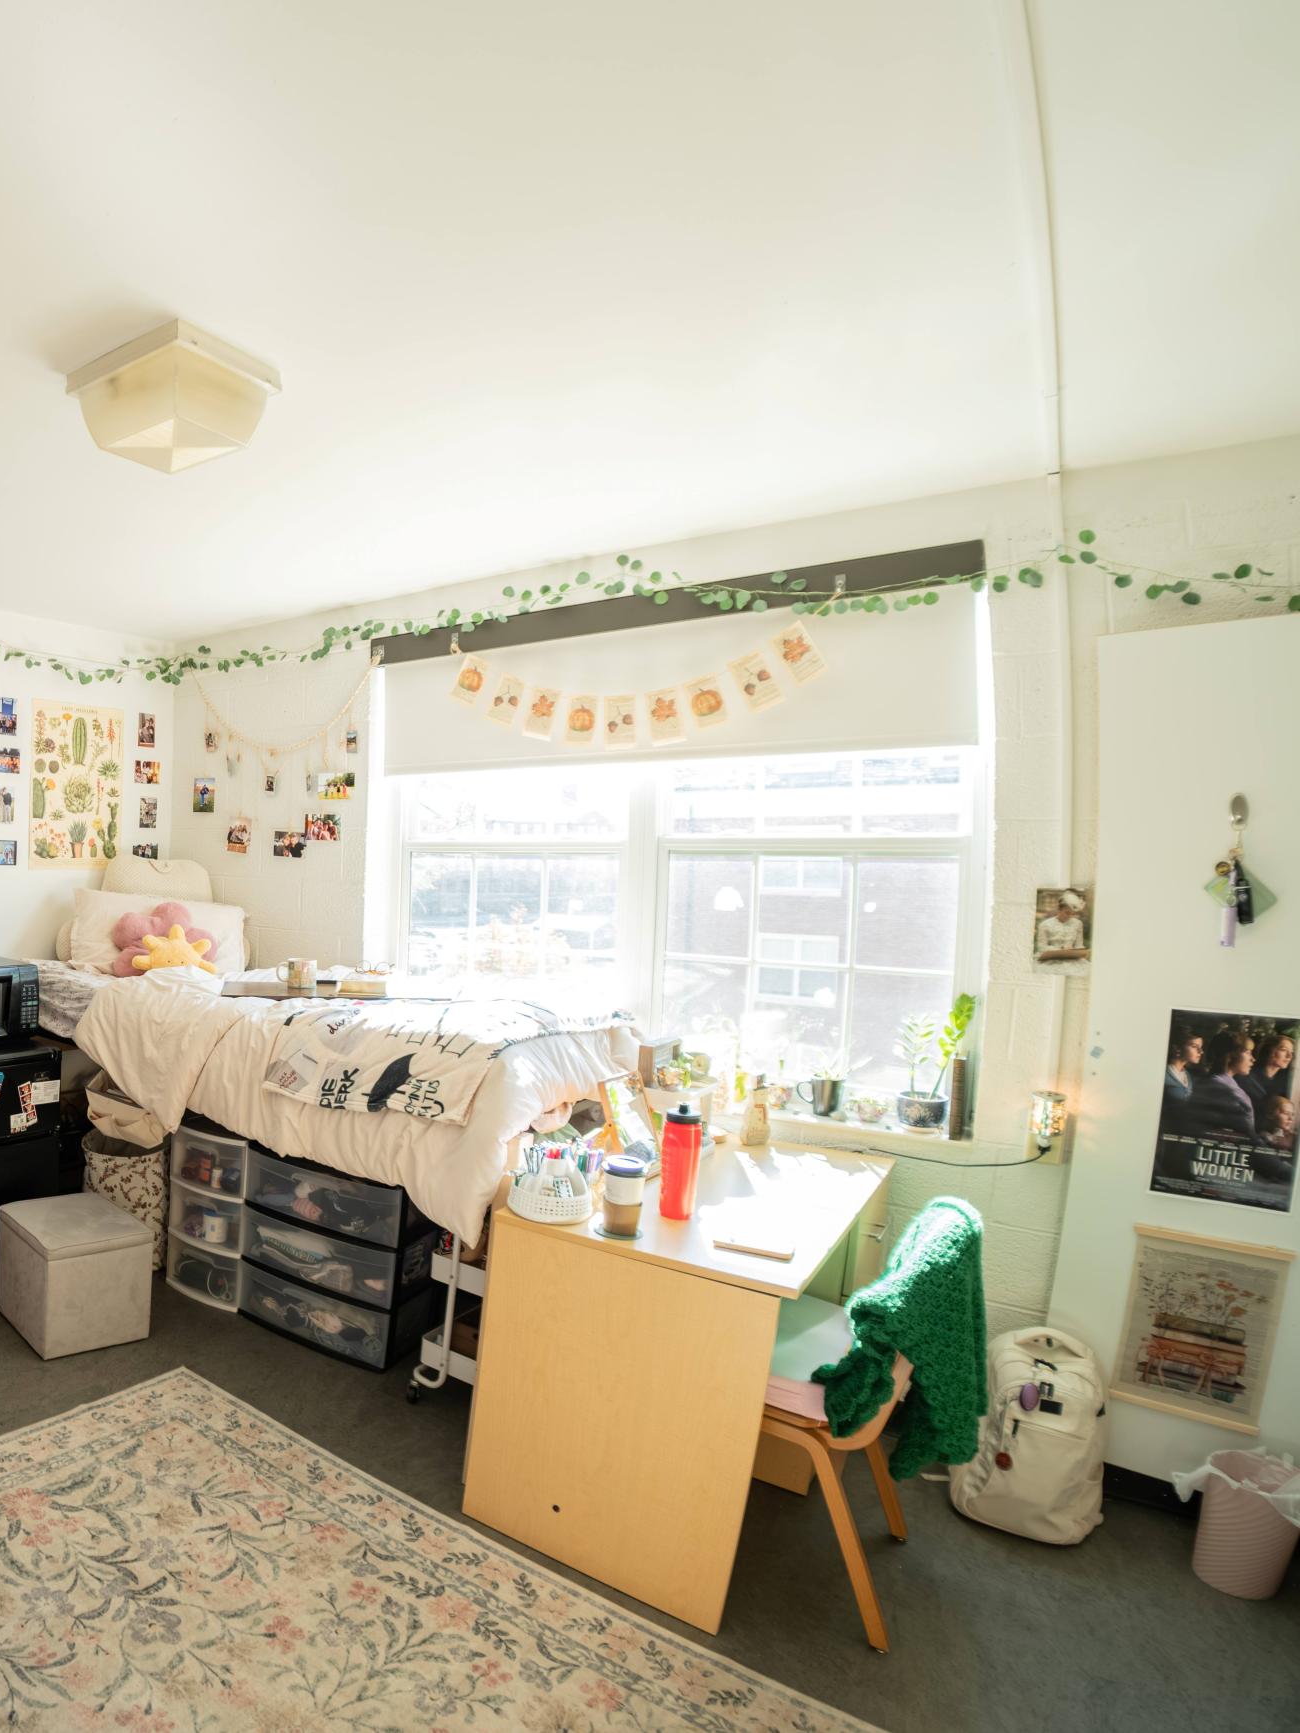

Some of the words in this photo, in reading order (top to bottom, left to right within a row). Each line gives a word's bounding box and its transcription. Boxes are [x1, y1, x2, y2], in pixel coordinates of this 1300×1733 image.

[319, 1078, 338, 1109] DIE
[1197, 1146, 1251, 1167] LITTLE
[1192, 1161, 1255, 1183] WOMEN
